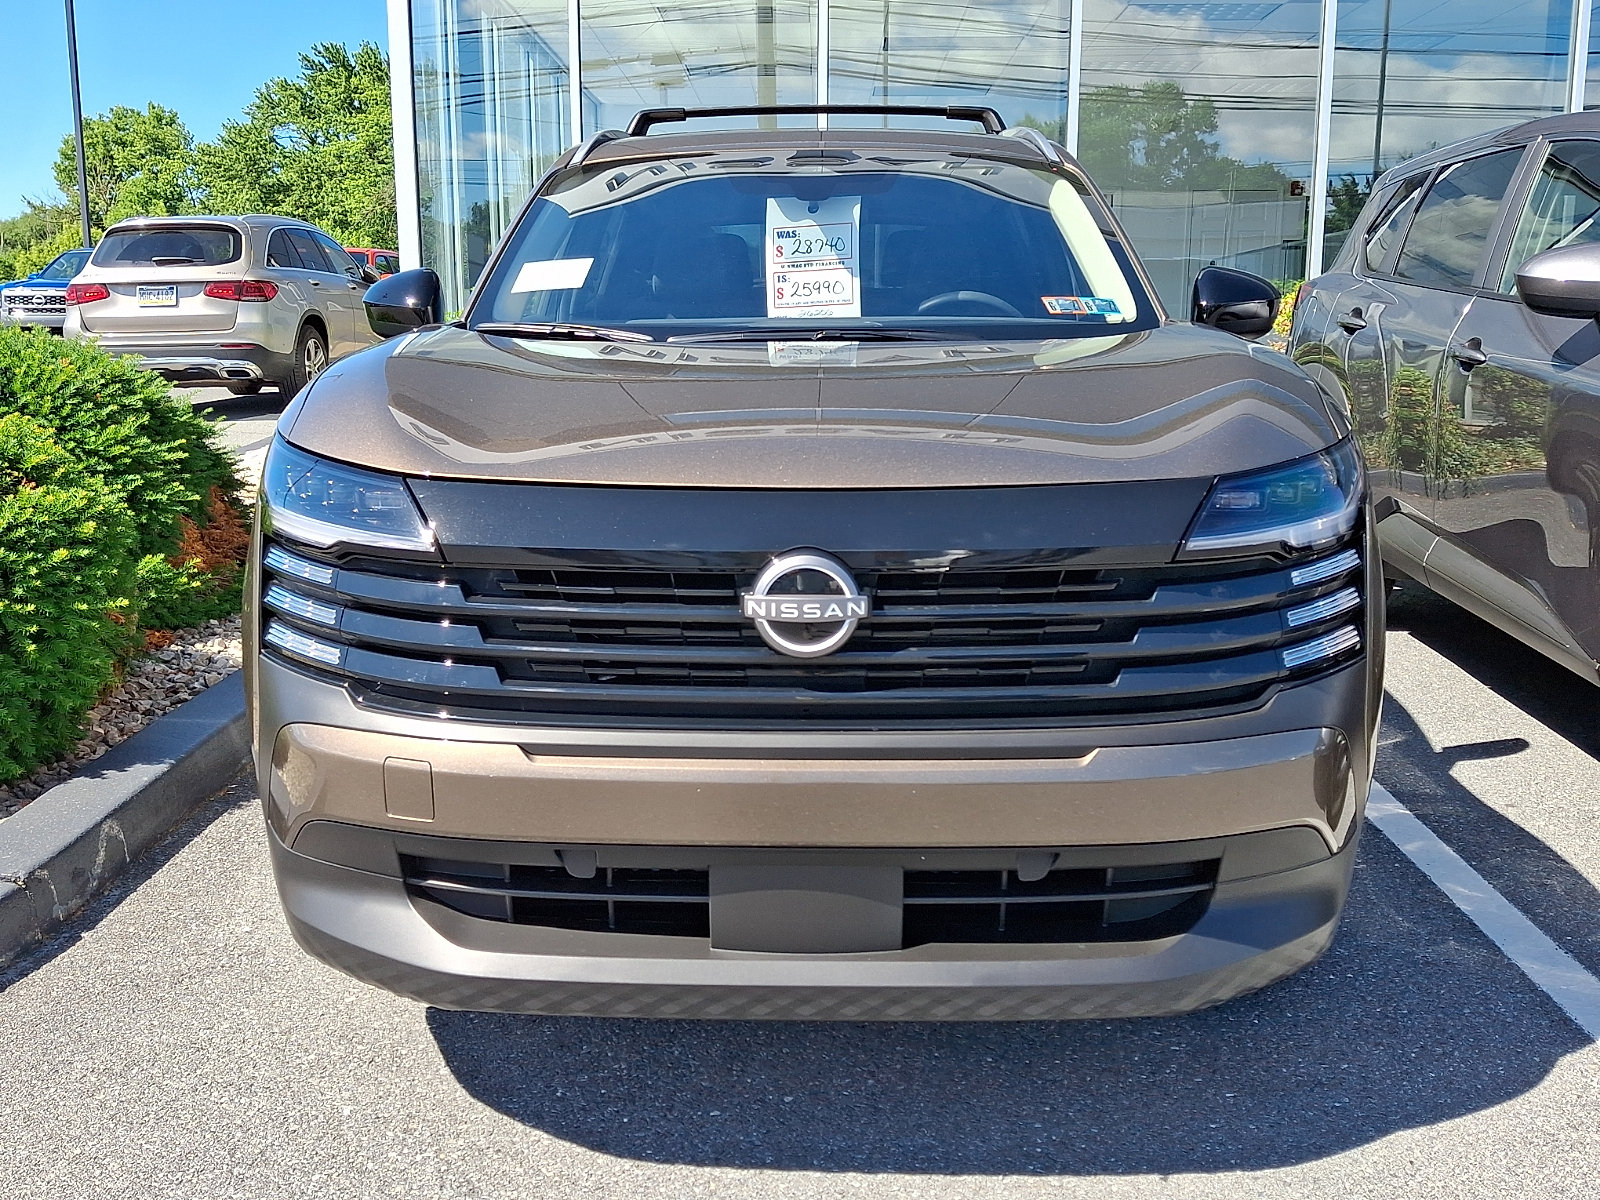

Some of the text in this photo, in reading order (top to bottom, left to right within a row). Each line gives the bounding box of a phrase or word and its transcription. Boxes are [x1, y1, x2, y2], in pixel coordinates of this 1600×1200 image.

[776, 230, 801, 239] WAS:
[775, 237, 846, 258] $ 28740
[777, 275, 791, 283] IS:
[776, 281, 844, 300] $ 25990
[746, 600, 865, 619] NISSAN
